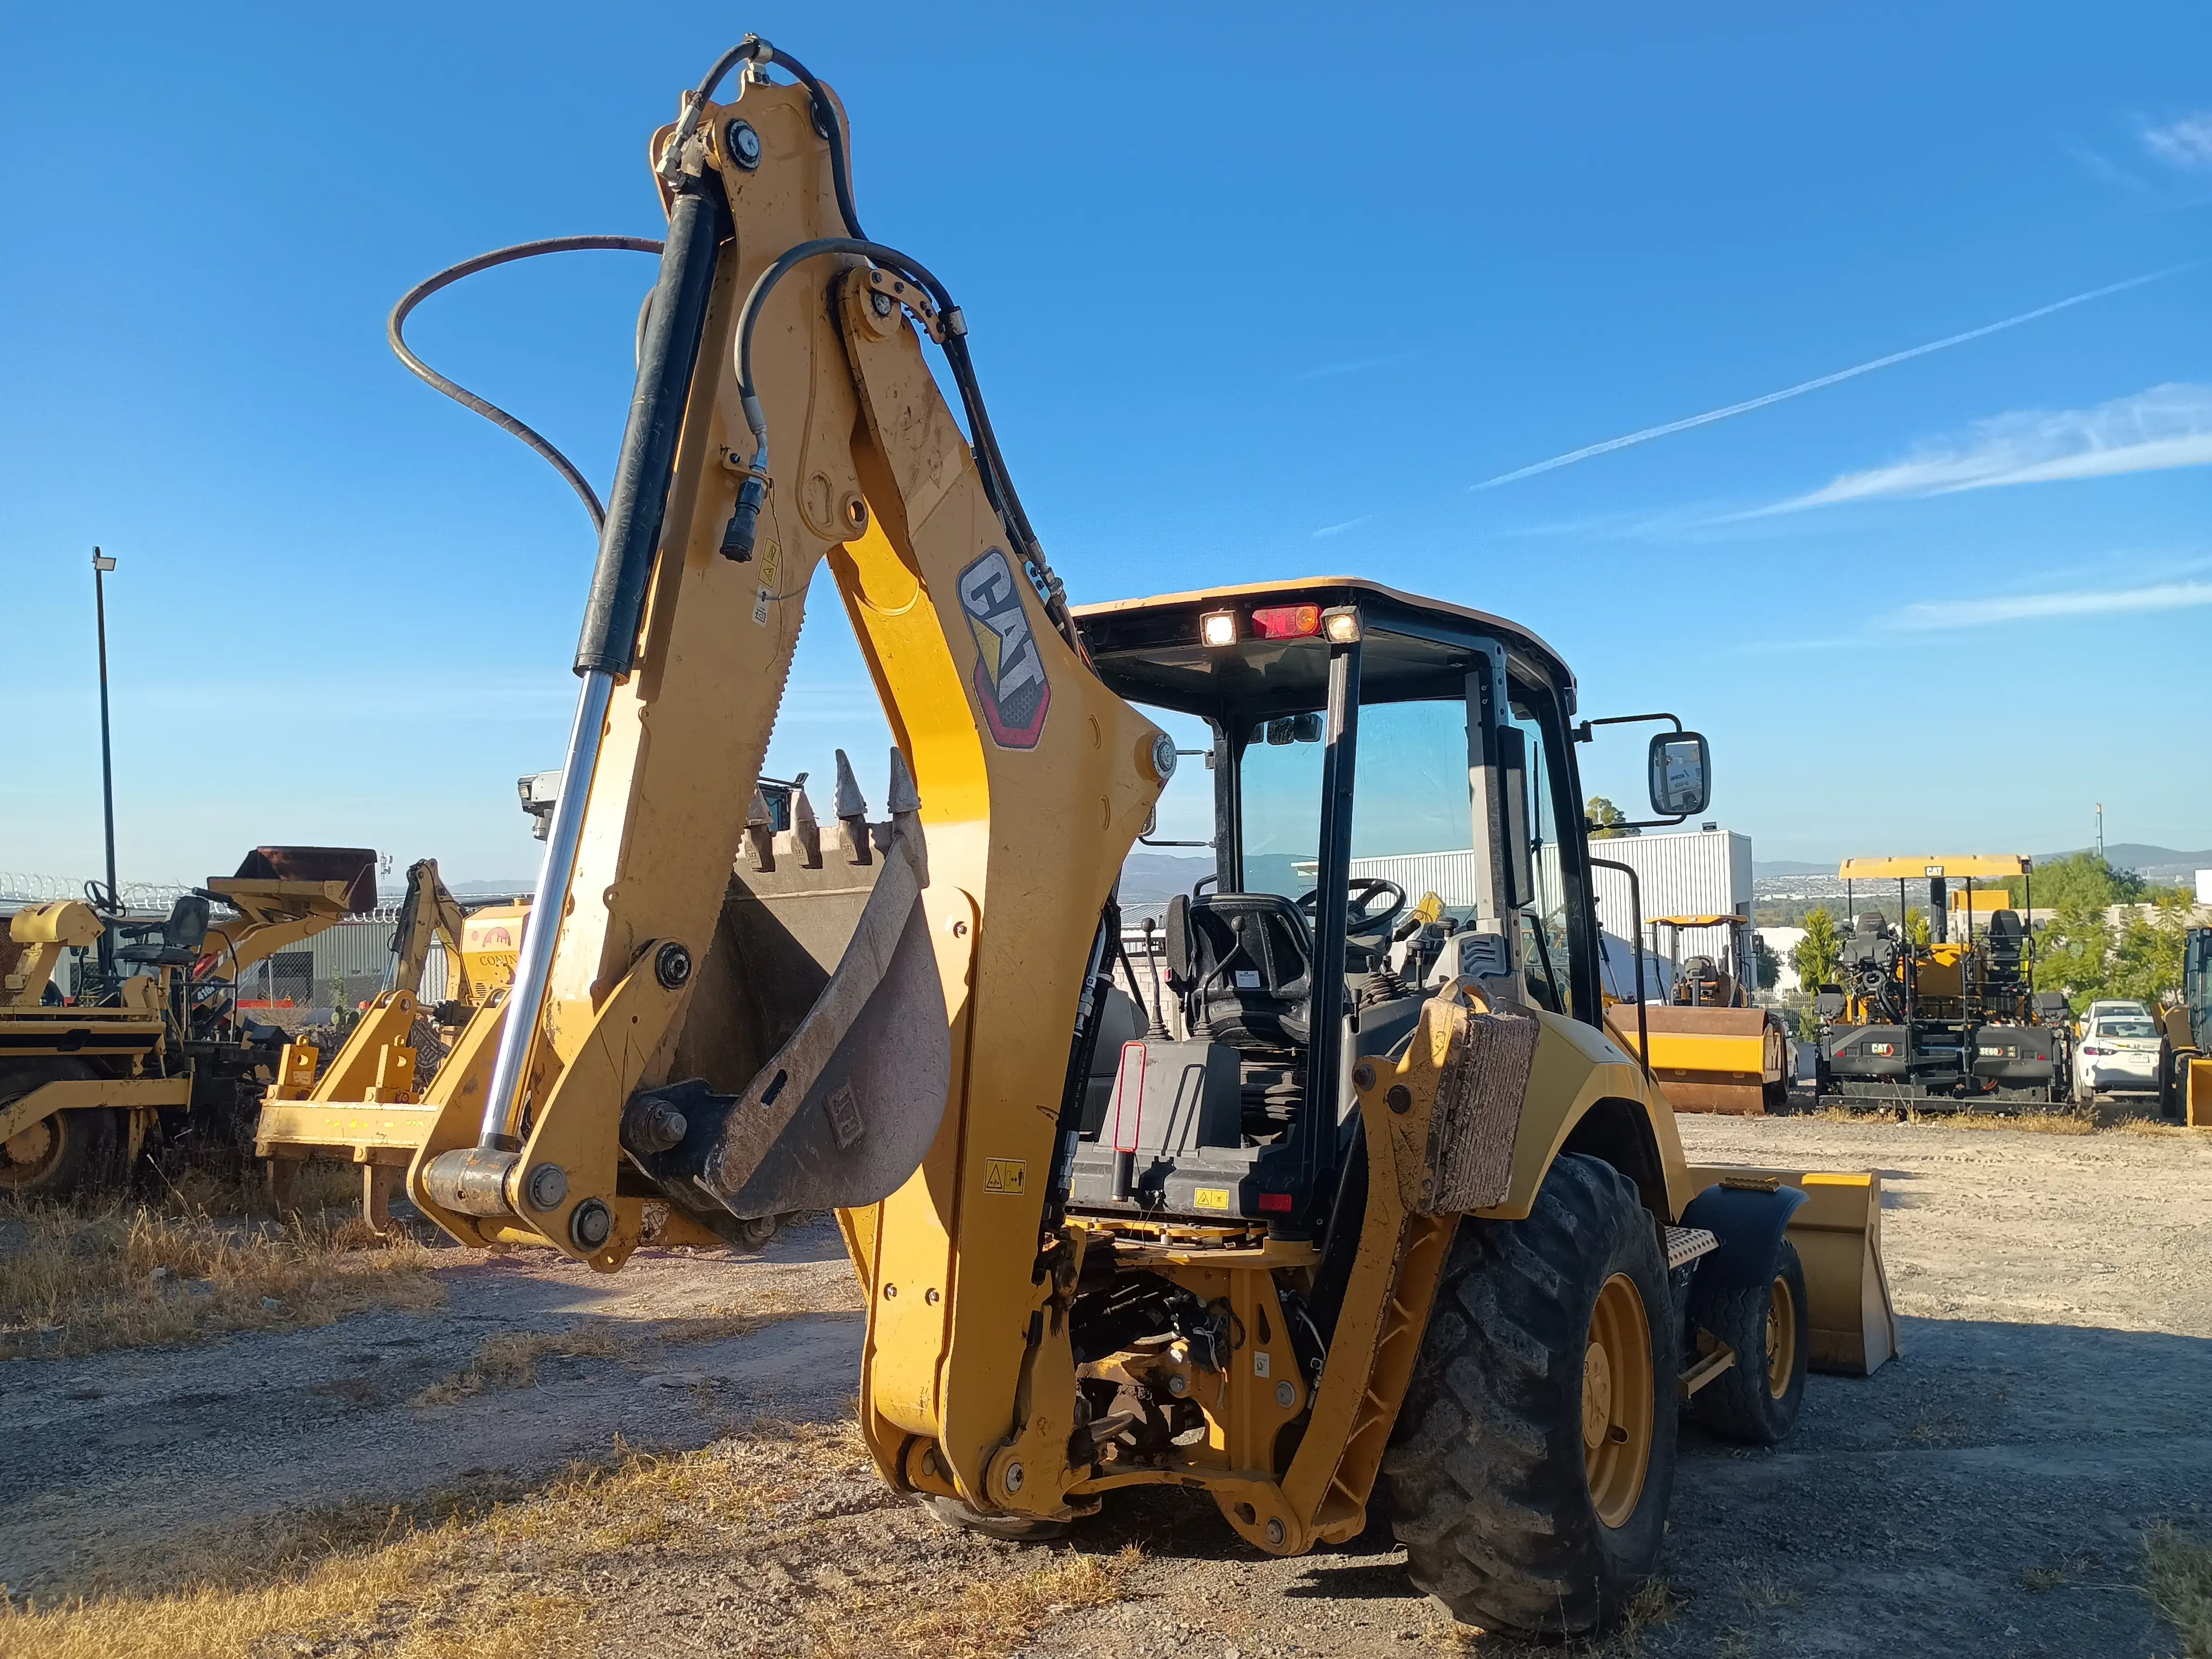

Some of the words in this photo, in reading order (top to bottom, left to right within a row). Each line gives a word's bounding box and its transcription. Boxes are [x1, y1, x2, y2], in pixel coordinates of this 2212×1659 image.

[961, 552, 1045, 703] CAT
[1926, 867, 1943, 876] CAT
[1872, 1043, 1888, 1054] CAT
[834, 1091, 862, 1141] CAT
